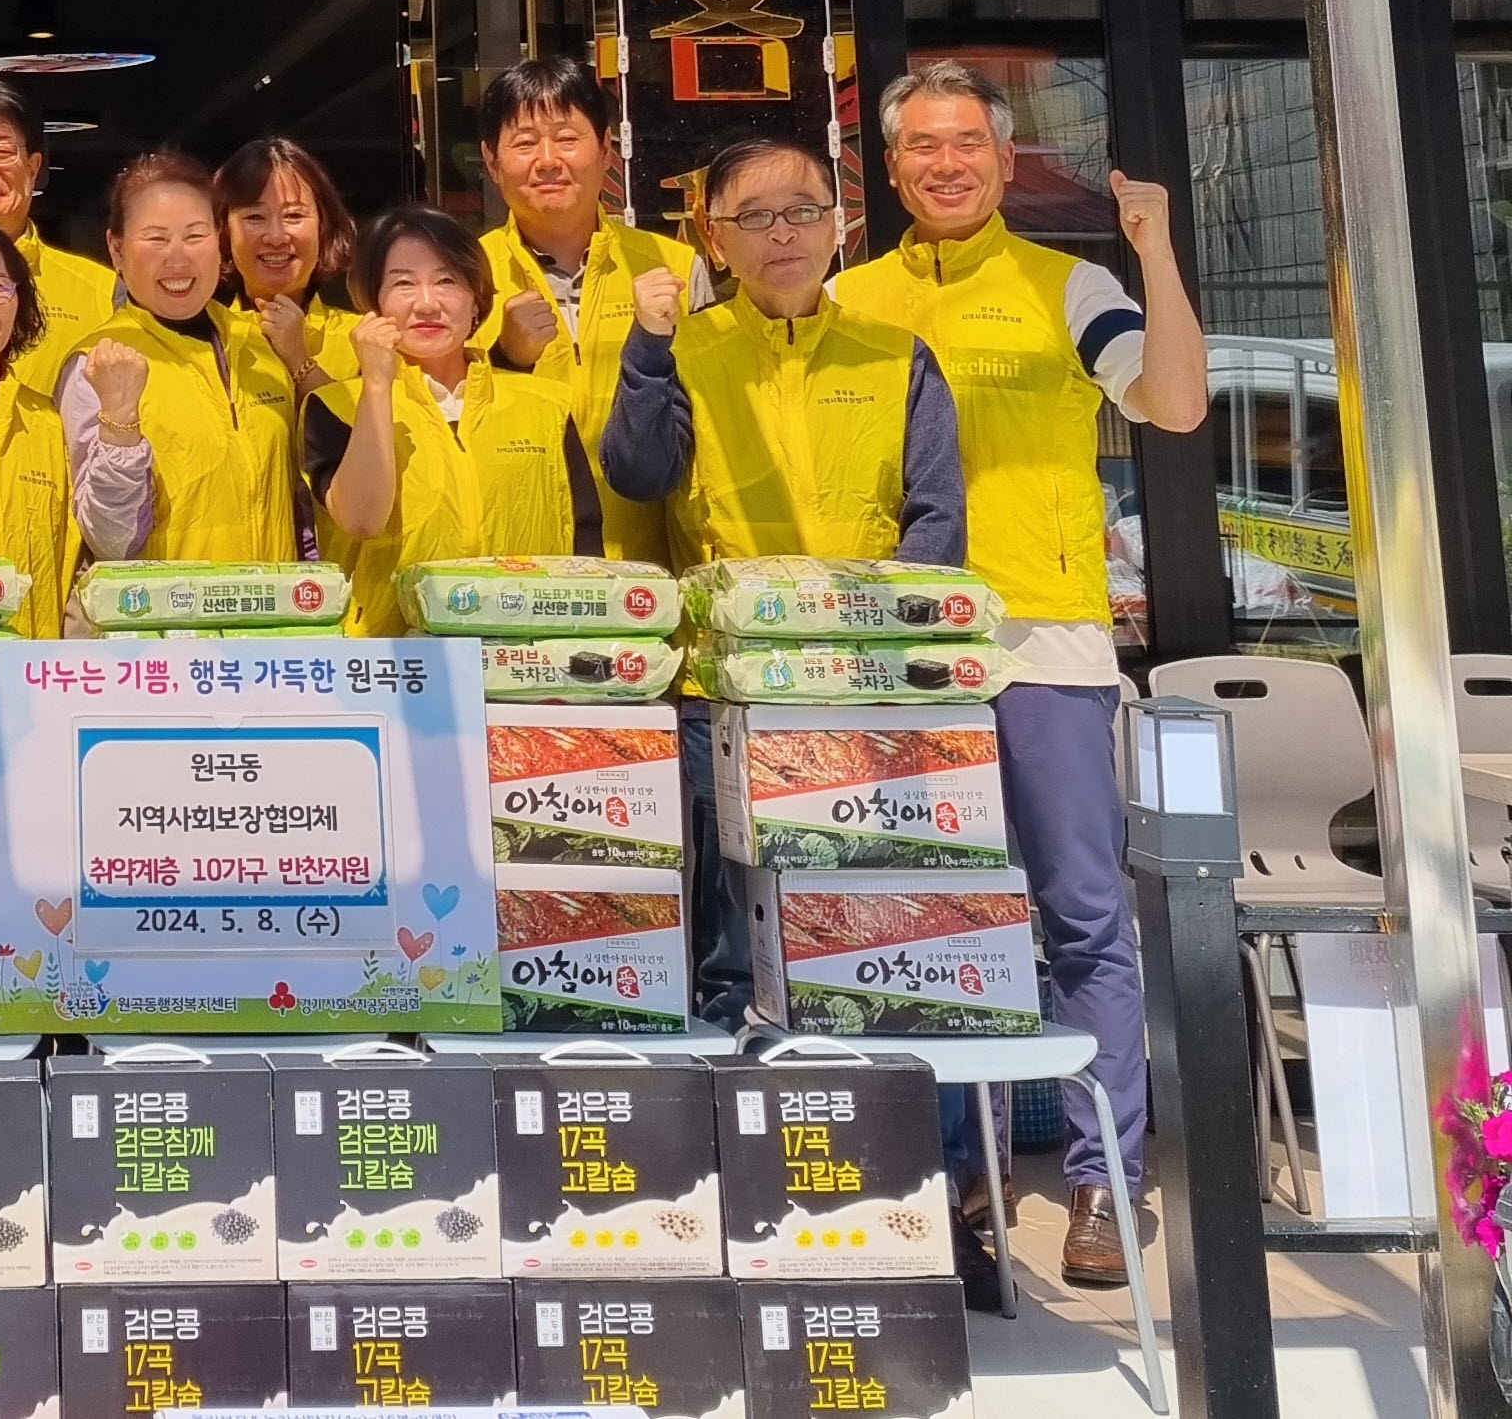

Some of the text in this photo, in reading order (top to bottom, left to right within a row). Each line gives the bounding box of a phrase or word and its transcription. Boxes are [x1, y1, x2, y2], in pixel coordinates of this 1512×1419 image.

[170, 592, 195, 602] Fresh
[172, 600, 194, 611] Daily
[202, 597, 276, 613] 신선한 들기름
[500, 592, 525, 603] Fresh
[501, 600, 524, 611] Daily
[531, 601, 607, 616] 신선한 들기름
[796, 601, 817, 613] 성경
[839, 608, 884, 626] 녹차김
[24, 658, 429, 694] 나누는 기쁨, 행복 가득한 원곡동
[510, 666, 558, 683] 녹차김
[803, 665, 826, 679] 성경
[848, 673, 896, 691] 녹차김
[190, 753, 263, 783] 원곡동
[505, 781, 602, 822] 아침애
[629, 801, 657, 816] 김치
[831, 788, 931, 831] 아침애
[958, 806, 989, 822] 김치
[118, 804, 339, 835] 지역사회보장협의체
[89, 855, 371, 887] 취약계층 10가구 반찬지원
[134, 905, 342, 937] 2024. 5. 8. (수)
[512, 949, 612, 993] 아침애
[640, 970, 668, 987] 김치
[856, 950, 956, 992] 아침애
[983, 967, 1012, 983] 김치
[116, 996, 240, 1014] 원곡동행정복지센터
[299, 997, 323, 1015] 경기
[113, 1092, 189, 1124] 검은콩
[336, 1089, 412, 1120] 검은콩
[557, 1090, 633, 1123] 검은콩
[779, 1090, 856, 1122] 검은콩
[115, 1126, 216, 1158] 검은참깨
[338, 1123, 439, 1156] 검은참깨
[558, 1126, 607, 1157] 17곡
[781, 1126, 831, 1157] 17곡
[115, 1161, 191, 1193] 고칼슘
[339, 1159, 414, 1190] 고칼슘
[561, 1160, 638, 1193] 고칼슘
[785, 1160, 862, 1192] 고칼슘
[123, 1308, 201, 1341] 검은콩
[352, 1305, 429, 1338] 검은콩
[578, 1303, 655, 1336] 검은콩
[804, 1306, 882, 1339] 검은콩
[124, 1344, 173, 1376] 17곡
[352, 1341, 402, 1374] 17곡
[579, 1338, 628, 1371] 17곡
[806, 1341, 855, 1375] 17곡
[124, 1378, 202, 1412] 고칼슘
[355, 1377, 432, 1408] 고칼슘
[582, 1375, 659, 1407] 고칼슘
[809, 1376, 887, 1410] 고칼슘
